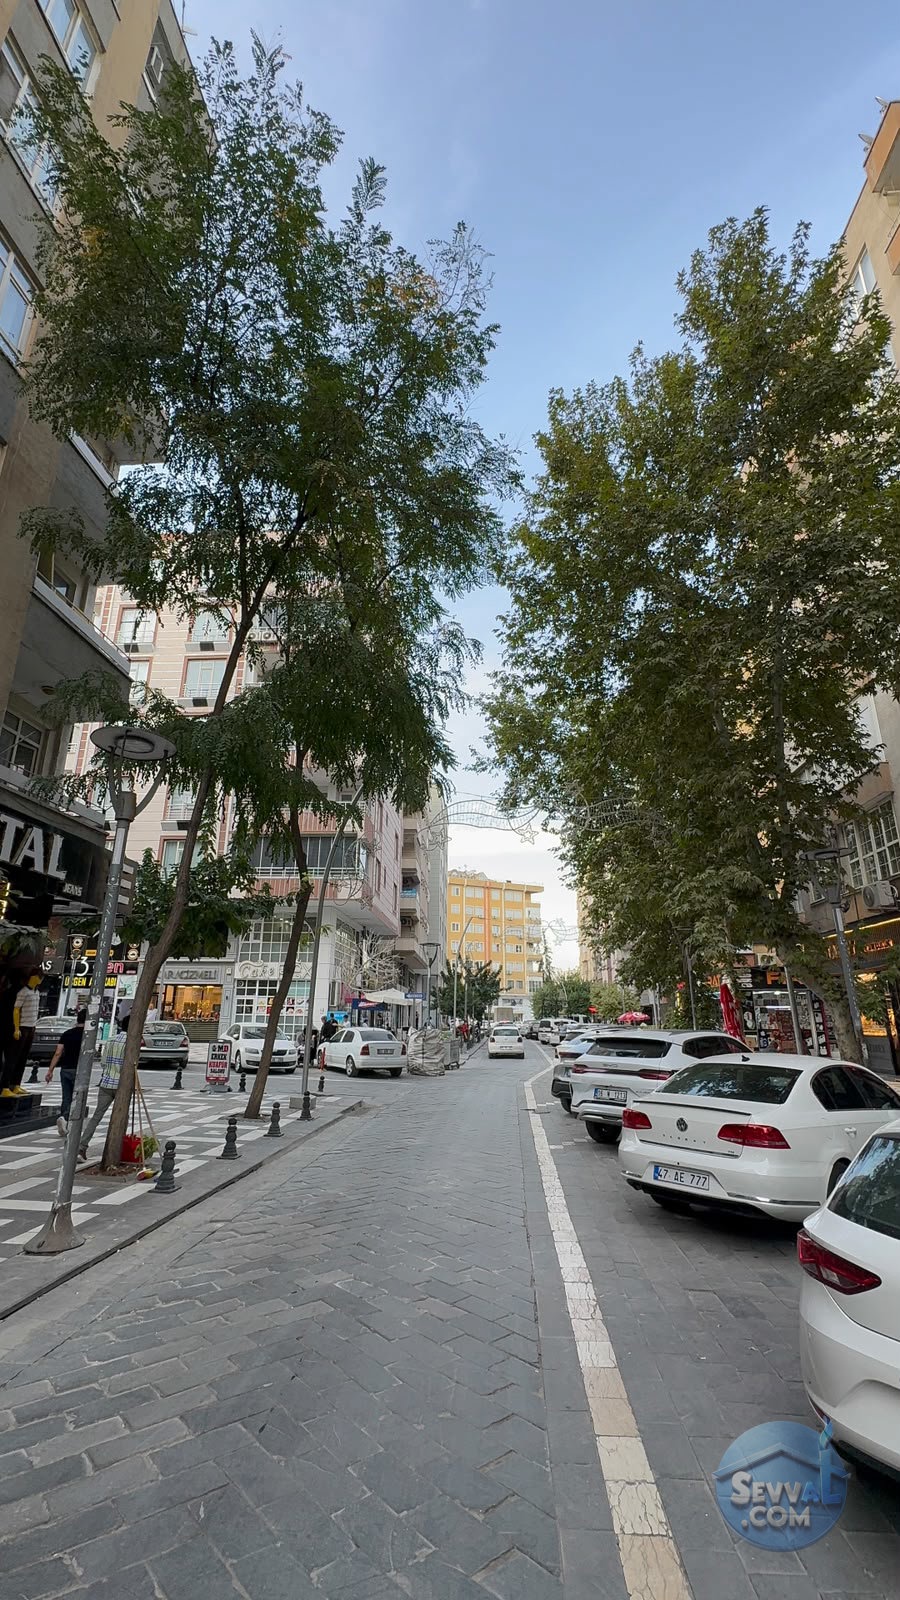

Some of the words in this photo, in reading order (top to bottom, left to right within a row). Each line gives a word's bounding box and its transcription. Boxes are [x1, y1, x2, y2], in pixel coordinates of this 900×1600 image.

[63, 882, 83, 897] JEANS
[658, 1167, 669, 1180] 47
[674, 1171, 685, 1183] AE
[690, 1174, 708, 1187] 777
